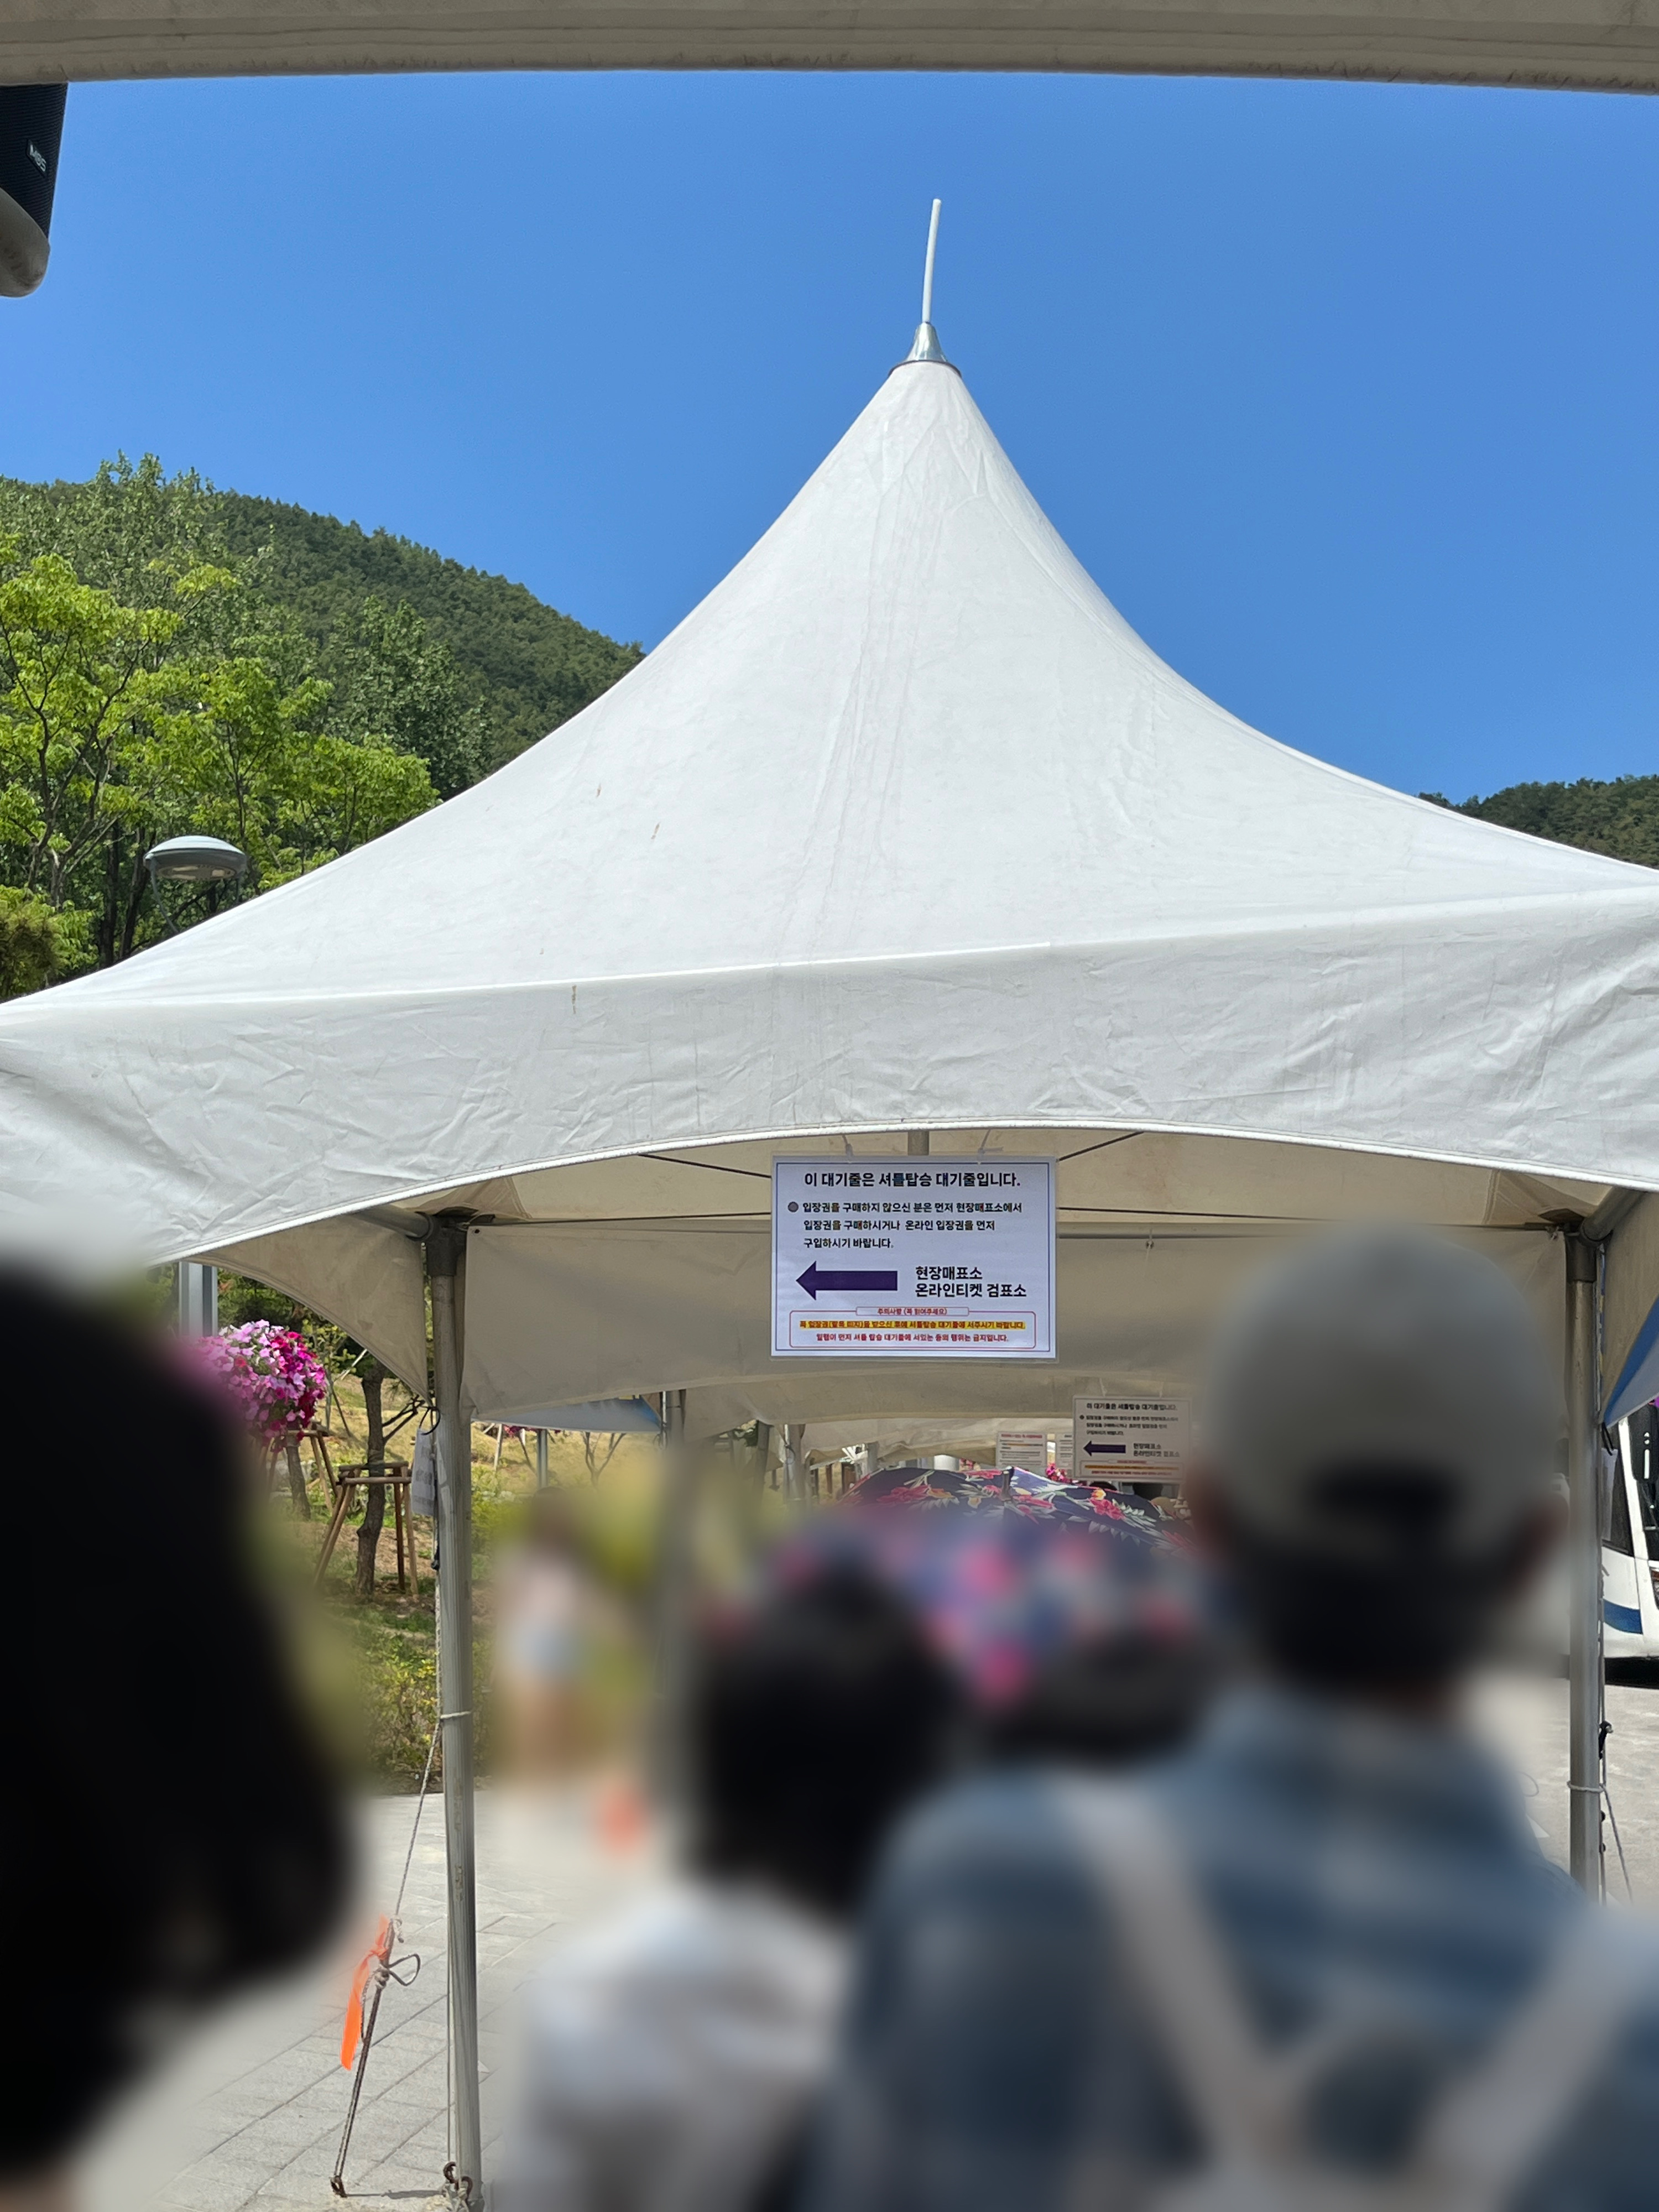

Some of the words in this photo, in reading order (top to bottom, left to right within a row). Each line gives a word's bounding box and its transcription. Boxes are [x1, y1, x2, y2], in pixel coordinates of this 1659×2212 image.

[805, 1172, 817, 1187] 이
[821, 1172, 875, 1187] 대기줄은
[878, 1172, 932, 1187] 셔틀탑승
[936, 1172, 1021, 1187] 대기줄입니다.
[802, 1202, 840, 1213] 입장권을
[843, 1202, 880, 1213] 구매하지
[883, 1202, 911, 1213] 않으신
[914, 1202, 932, 1213] 분은
[935, 1202, 953, 1213] 먼저
[956, 1202, 1022, 1213] 현장매표소에서
[804, 1220, 841, 1231] 입장권을
[843, 1220, 900, 1231] 구매하시거나
[905, 1220, 933, 1231] 온라인
[936, 1220, 973, 1231] 입장권을
[977, 1220, 995, 1230] 먼저
[804, 1238, 851, 1249] 구입하시기
[853, 1238, 894, 1249] 바랍니다.
[915, 1266, 983, 1280] 현장매표소
[915, 1283, 982, 1297] 온라인티켓
[987, 1284, 1027, 1297] 검표소
